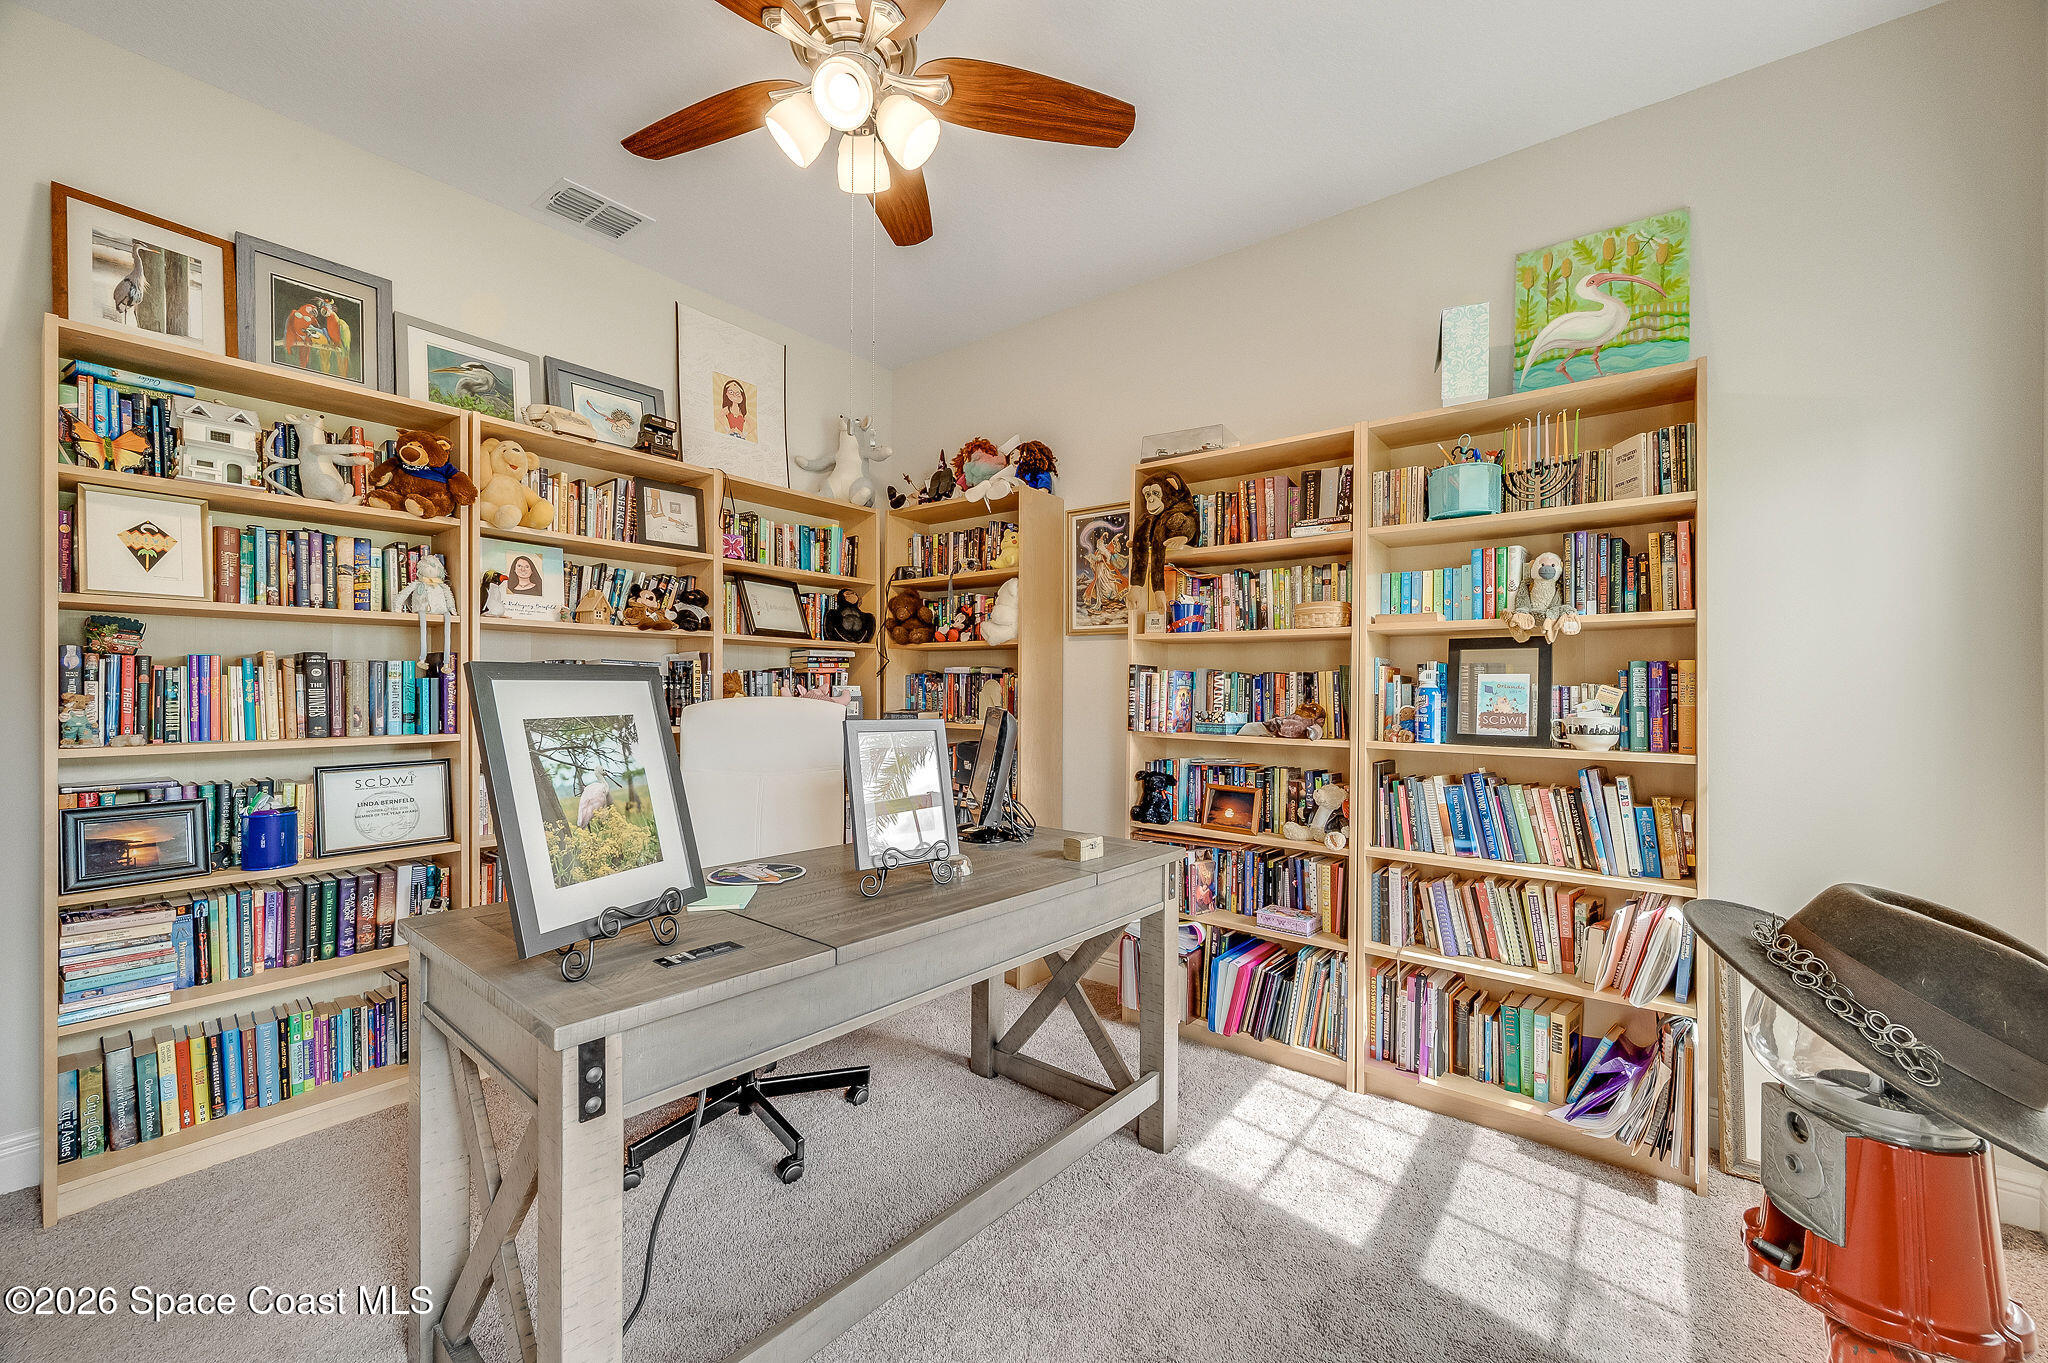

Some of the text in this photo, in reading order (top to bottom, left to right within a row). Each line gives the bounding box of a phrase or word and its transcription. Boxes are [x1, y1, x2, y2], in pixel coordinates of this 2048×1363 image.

[95, 390, 103, 413] ALEXIE
[616, 494, 625, 530] SEEKER
[1632, 667, 1647, 707] COMEBACK
[123, 687, 133, 714] TAKEN
[308, 688, 327, 717] DIVINERS
[391, 681, 401, 719] BEAUTY QUEENS
[1482, 715, 1522, 725] SCBWI
[355, 772, 415, 789] scbwi
[221, 801, 231, 813] Deep
[380, 797, 415, 806] BERNFELD
[1515, 789, 1523, 803] Bear
[1452, 794, 1464, 831] DICTIONARY
[1572, 809, 1582, 836] SYNTAX
[1657, 818, 1671, 860] NORA ROBERTS
[326, 899, 334, 922] WIZARD
[362, 895, 370, 917] CROWN
[1560, 903, 1568, 919] MEG
[309, 925, 317, 939] HEIR
[325, 922, 333, 936] HEIR
[1562, 925, 1569, 936] JO
[1505, 1010, 1515, 1036] REFLEX
[1552, 1022, 1563, 1055] MIAMI
[229, 1053, 237, 1089] MOCKINGJAY
[113, 1063, 128, 1131] Clockwork Princess
[144, 1078, 154, 1111] Clockwork
[162, 1075, 174, 1100] YOUR
[60, 1100, 76, 1120] City
[84, 1094, 100, 1116] City
[145, 1112, 155, 1132] Prince
[61, 1131, 74, 1157] Ashes
[87, 1124, 101, 1151] Glass
